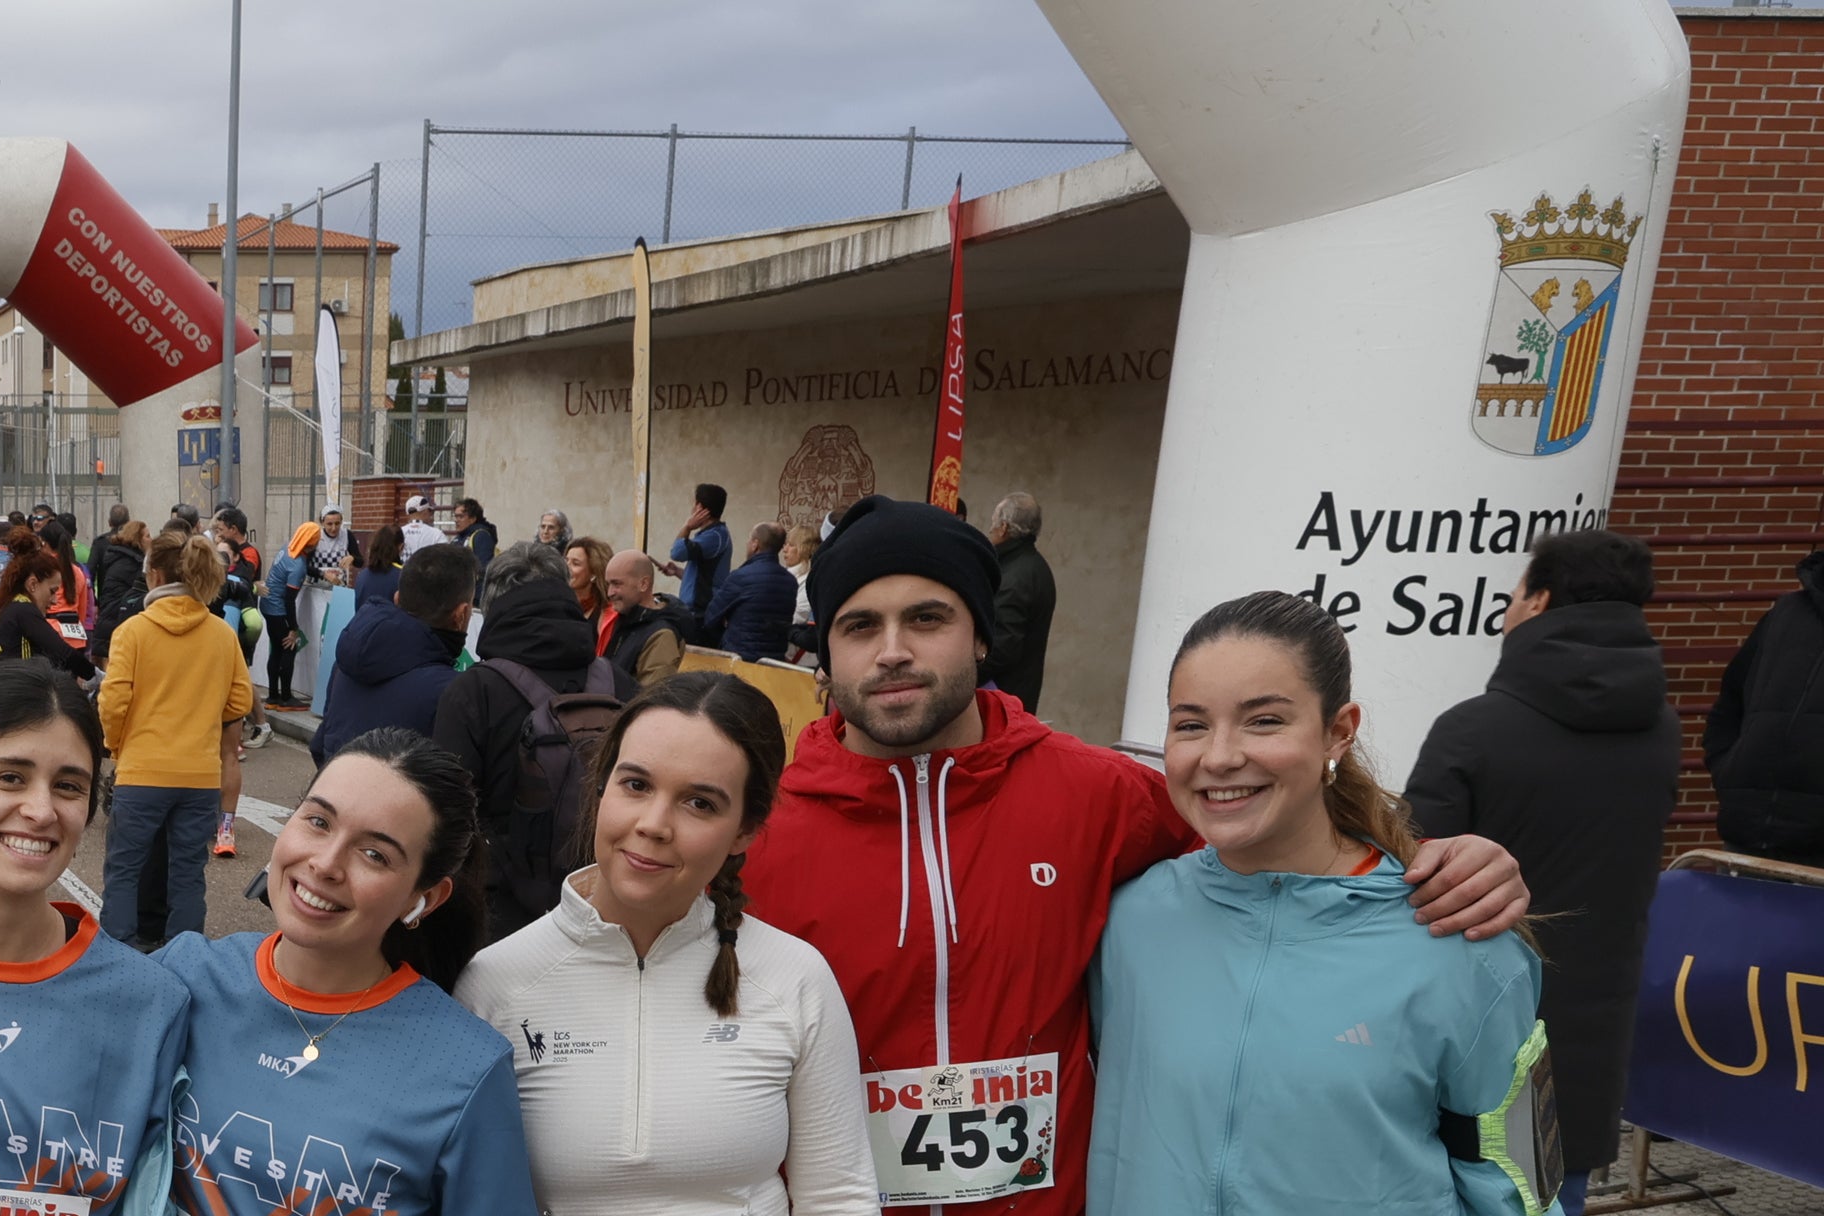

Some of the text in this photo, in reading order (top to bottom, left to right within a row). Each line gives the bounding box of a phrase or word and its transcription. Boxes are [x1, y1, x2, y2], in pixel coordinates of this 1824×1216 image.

[54, 238, 184, 367] DEPORTISTAS
[68, 208, 212, 352] CON NUESTROS
[564, 348, 1172, 416] UNIVESIDAD PONTIFICIA D SALAMANC
[258, 1053, 291, 1075] MKA
[932, 1097, 962, 1107] Km21
[901, 1105, 1029, 1172] 453
